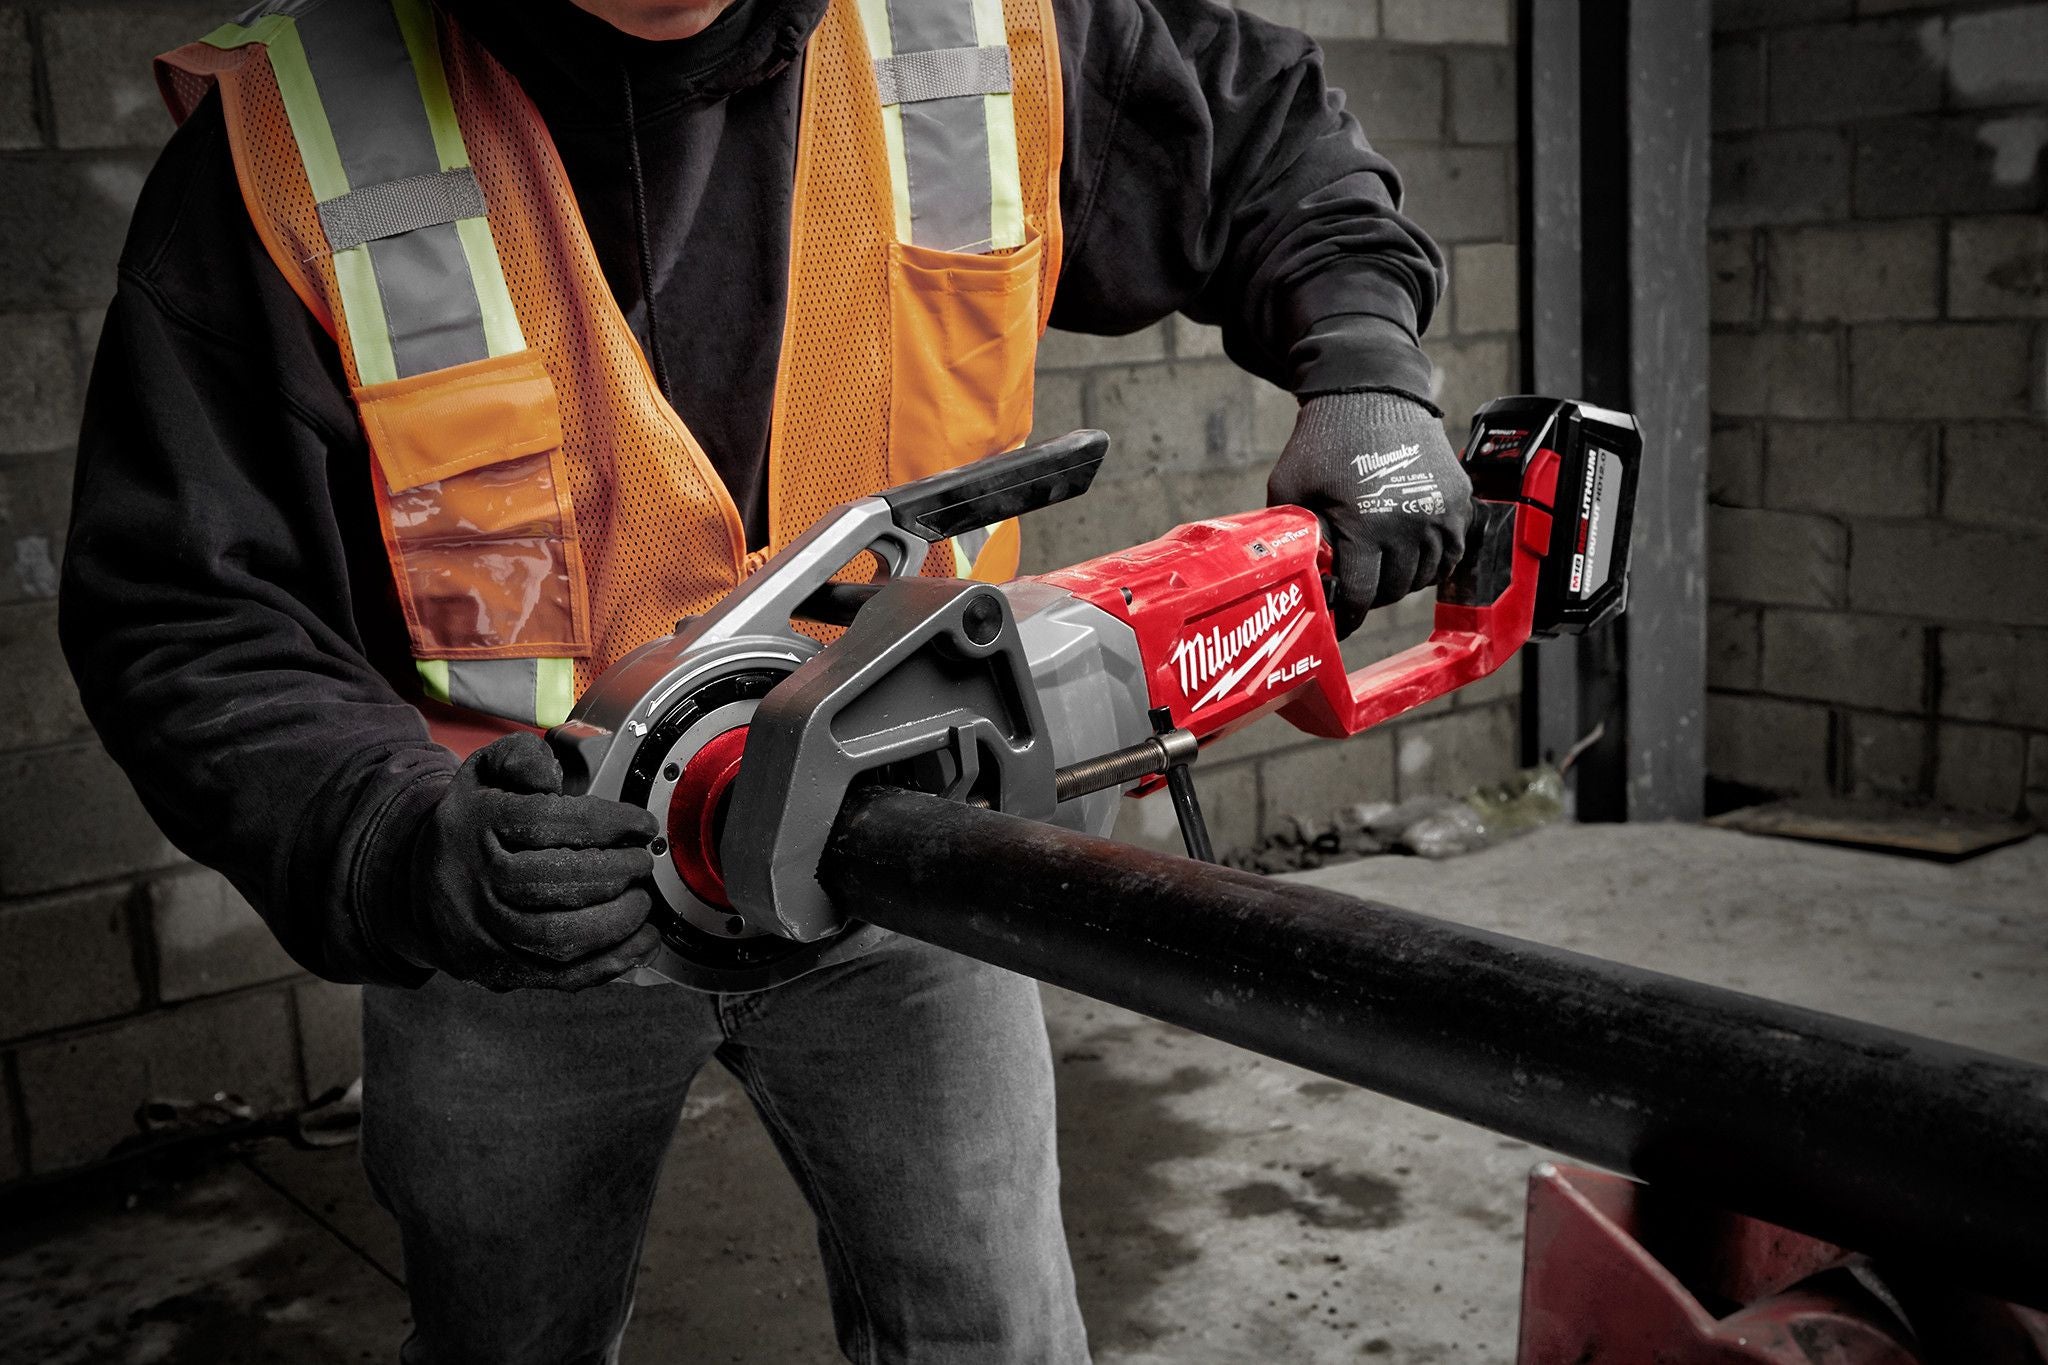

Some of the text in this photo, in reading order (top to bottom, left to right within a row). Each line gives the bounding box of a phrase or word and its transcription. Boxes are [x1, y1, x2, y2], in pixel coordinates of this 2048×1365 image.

[1350, 444, 1420, 476] Milwaukee
[1406, 473, 1428, 481] LEVEL
[1383, 498, 1398, 506] XL
[1588, 503, 1600, 557] OUTPUT
[1584, 558, 1594, 593] HIGH
[1170, 583, 1303, 697] Milwaukee
[1267, 655, 1322, 689] FUEL
